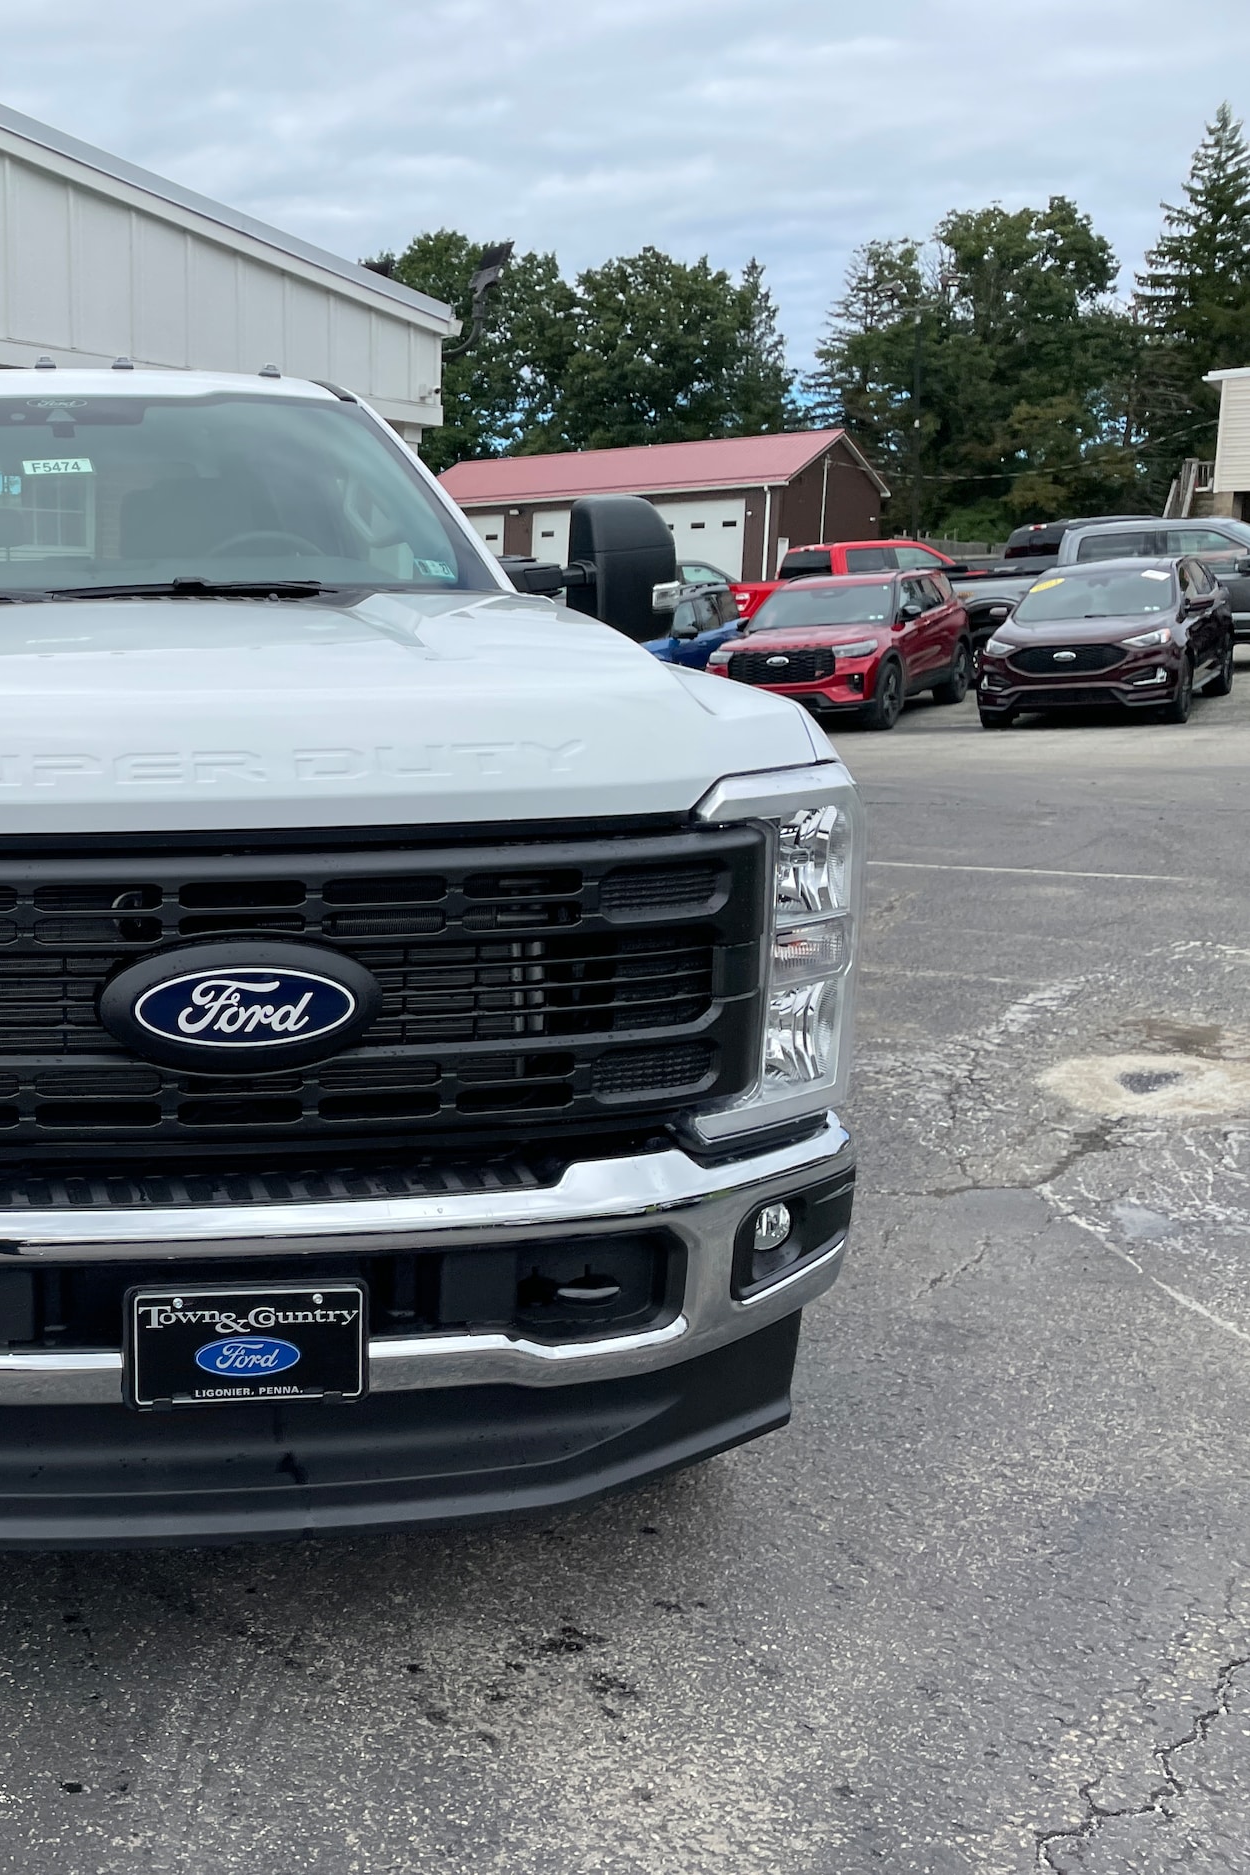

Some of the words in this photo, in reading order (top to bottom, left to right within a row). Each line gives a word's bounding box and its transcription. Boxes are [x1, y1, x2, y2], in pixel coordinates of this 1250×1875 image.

[37, 399, 77, 408] Ford
[31, 461, 81, 473] F5474
[292, 740, 586, 780] DUTY
[177, 979, 313, 1034] Ford
[215, 1343, 279, 1369] Ford
